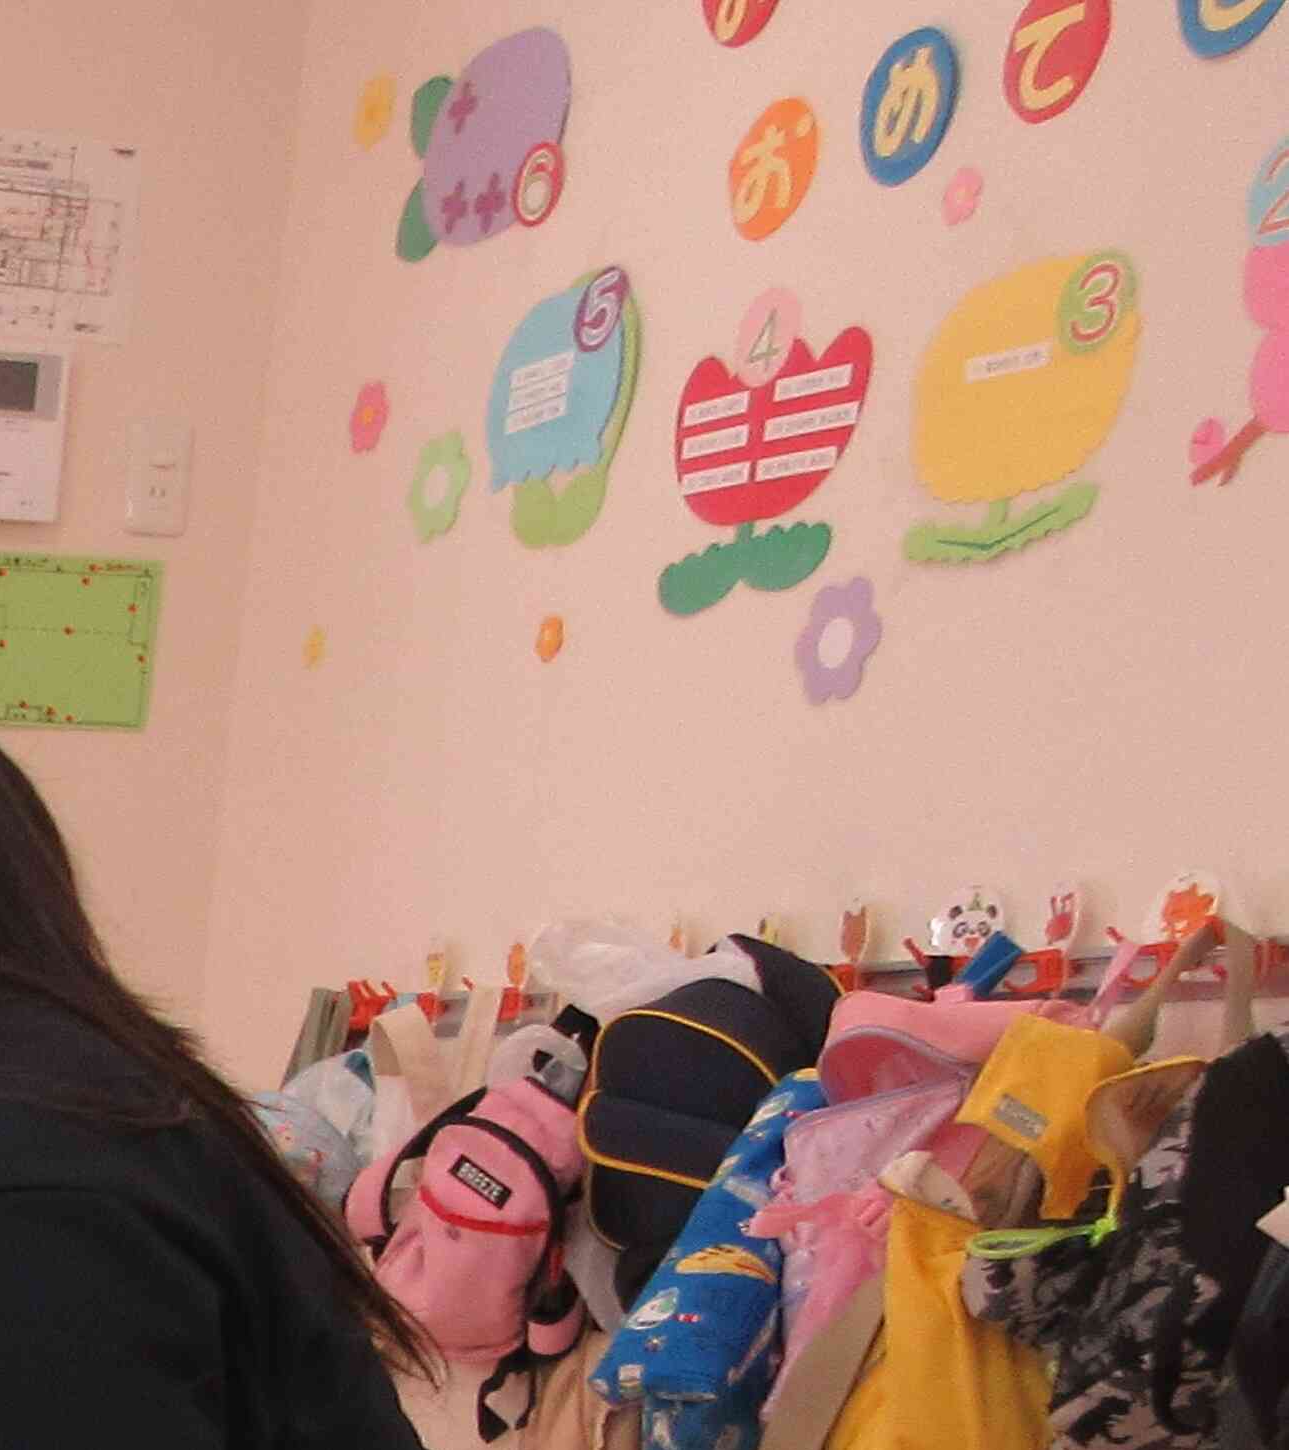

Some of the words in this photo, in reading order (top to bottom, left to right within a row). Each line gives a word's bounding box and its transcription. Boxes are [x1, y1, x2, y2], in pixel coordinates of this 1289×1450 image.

[518, 149, 553, 220] 6
[580, 269, 622, 347] 5
[1071, 261, 1121, 342] 3
[748, 307, 781, 372] 4
